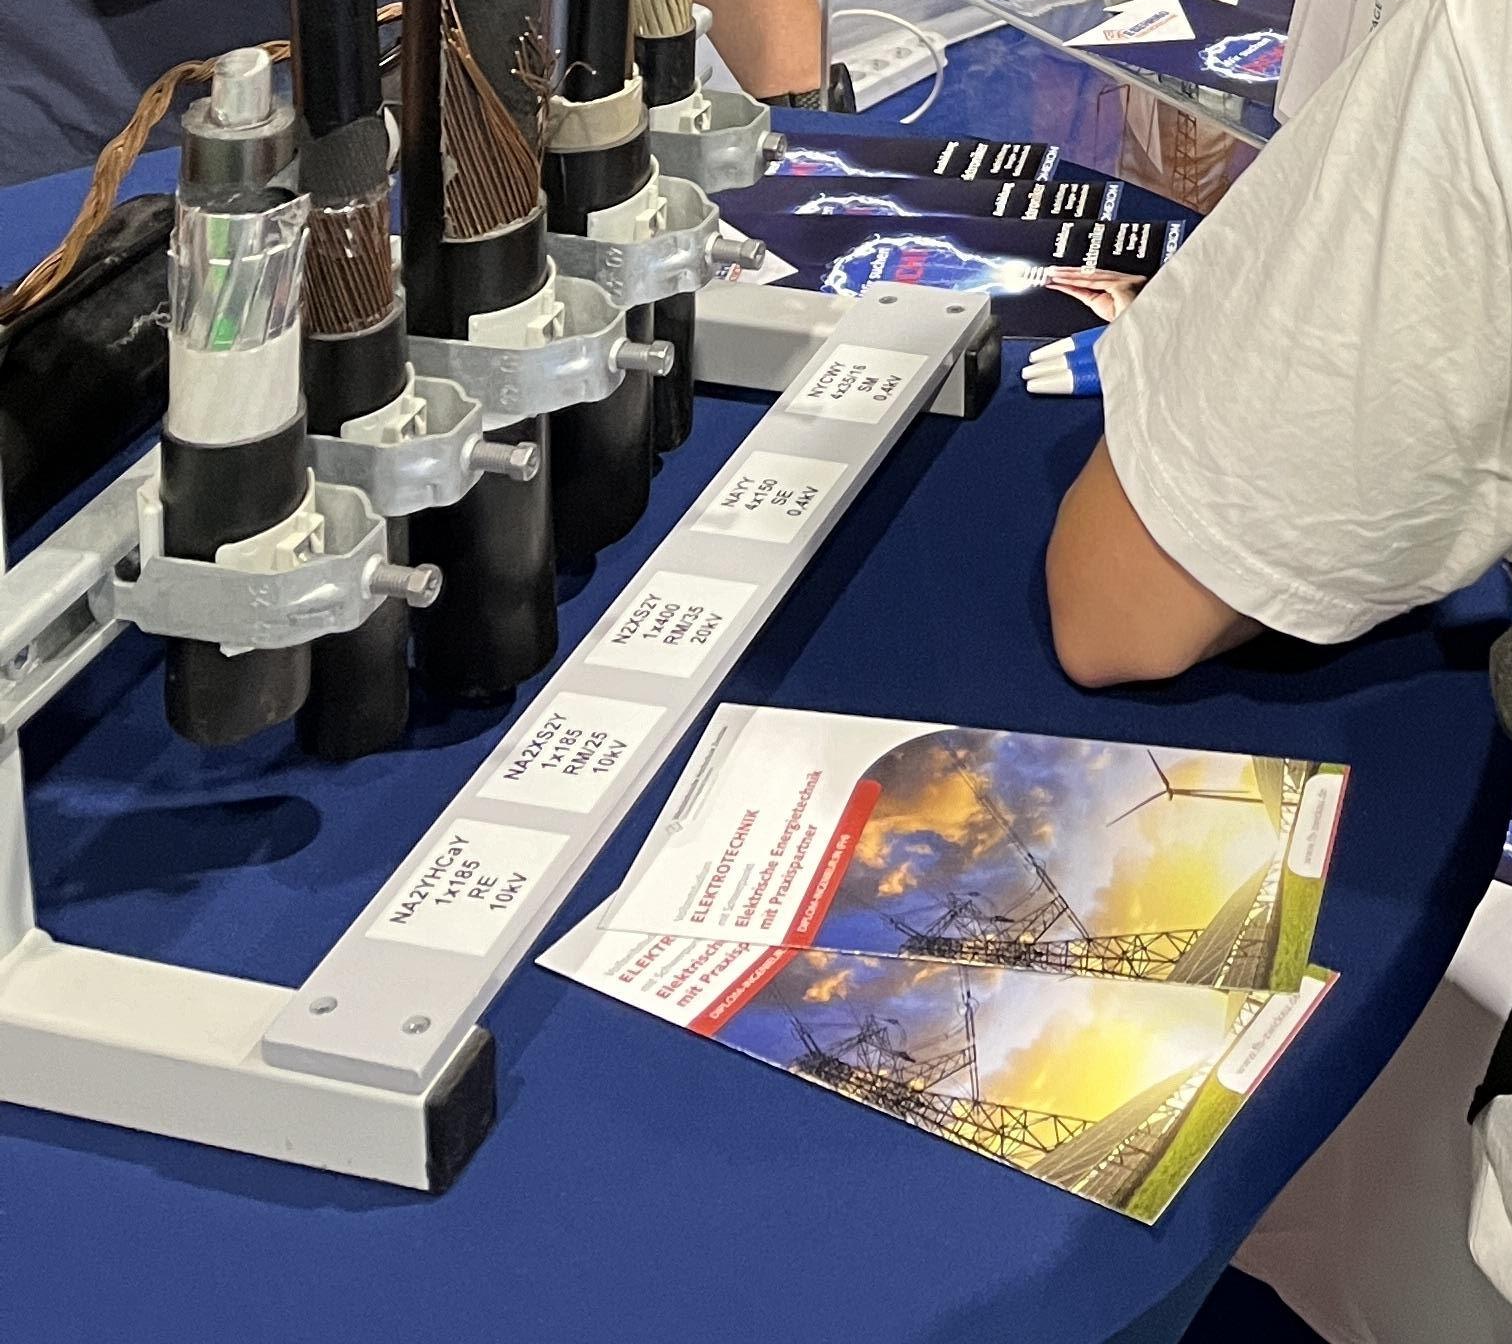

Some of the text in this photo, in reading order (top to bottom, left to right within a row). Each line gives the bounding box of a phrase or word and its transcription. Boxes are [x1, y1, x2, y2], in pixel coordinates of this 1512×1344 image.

[808, 361, 846, 398] NYCWY
[858, 377, 879, 392] SM
[720, 476, 755, 507] NAYY
[745, 478, 778, 510] 4x150
[771, 490, 794, 506] SE
[611, 593, 662, 644] N2XS2Y
[642, 603, 681, 639] 1x400
[663, 606, 704, 645] RM/35
[690, 613, 723, 644] 20kV
[503, 713, 567, 780] NA2XS2Y
[541, 729, 583, 769] 1x185
[562, 731, 608, 775] RM/25
[593, 739, 628, 773] 10kV
[690, 809, 760, 923] ELEKTROTECHNIK
[735, 770, 823, 928] Elektrische Energietechnik
[389, 835, 470, 924] NA2YHCaY
[435, 860, 481, 905] 1x185
[467, 875, 498, 900] RE
[490, 872, 527, 910] 10kV
[761, 823, 818, 930] mit Praxispartner
[677, 986, 703, 1007] mit
